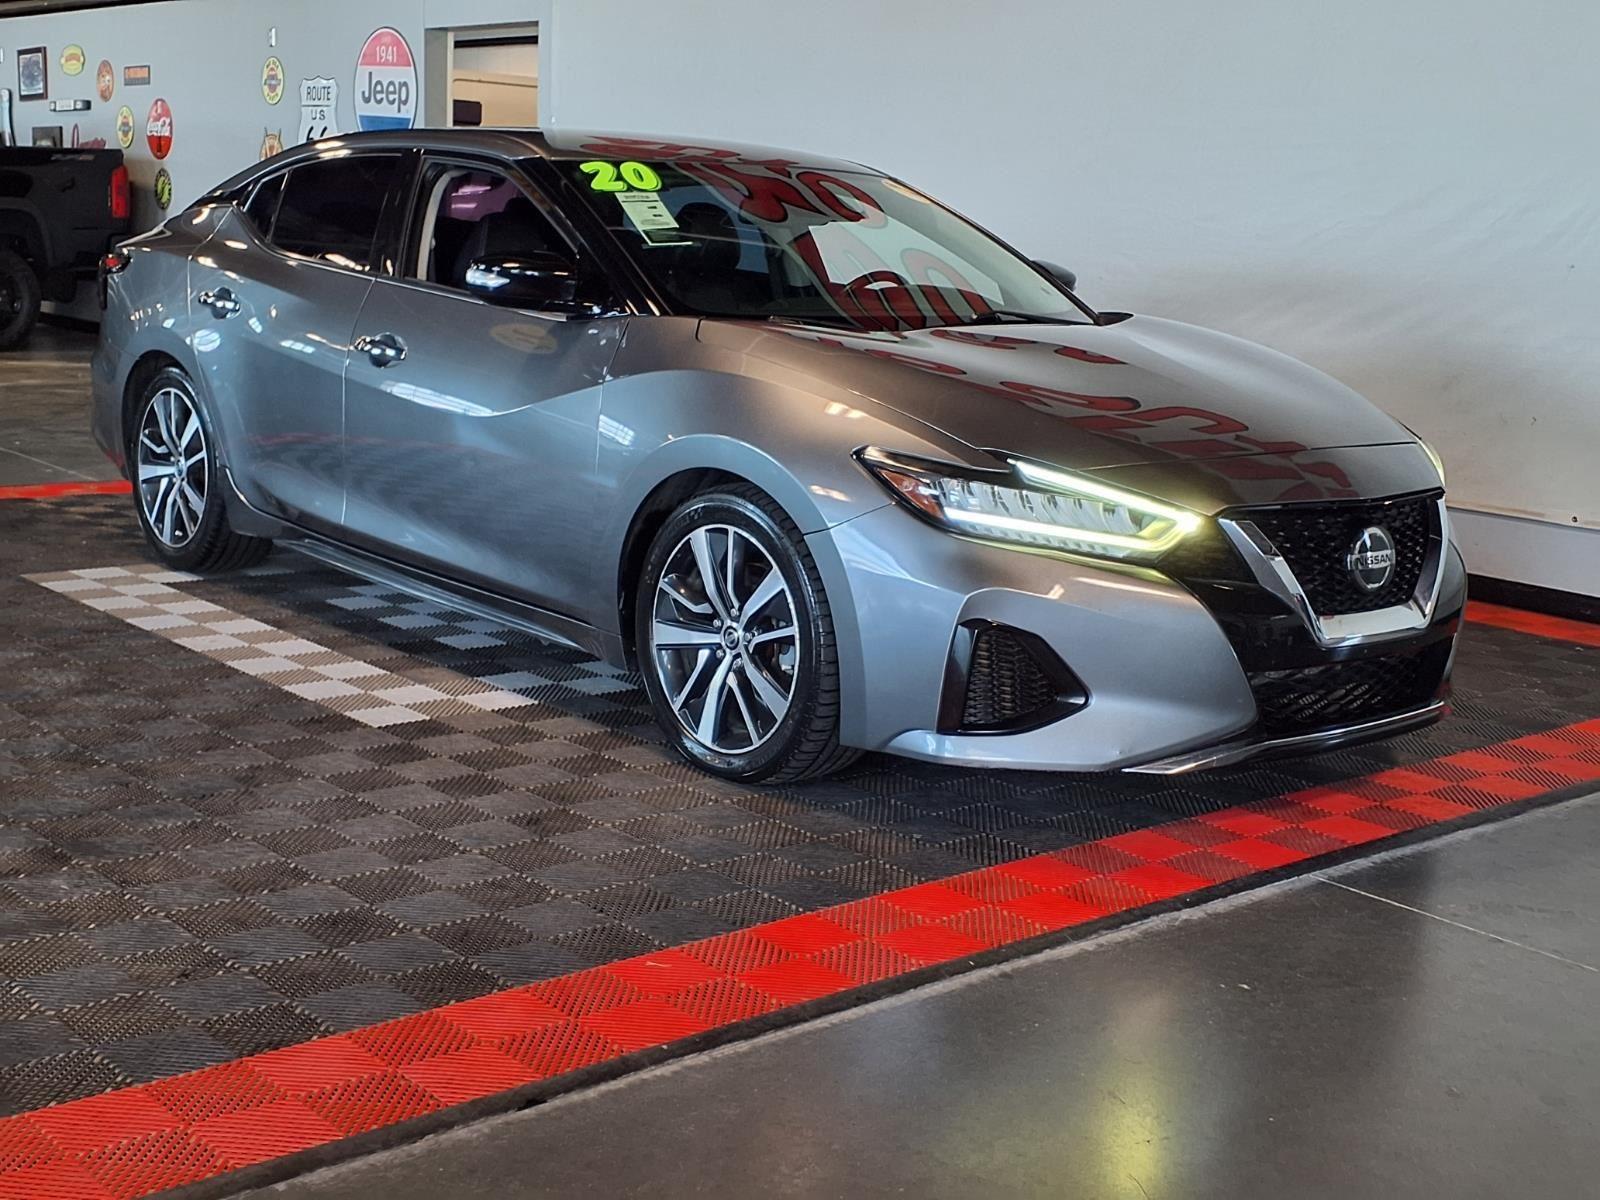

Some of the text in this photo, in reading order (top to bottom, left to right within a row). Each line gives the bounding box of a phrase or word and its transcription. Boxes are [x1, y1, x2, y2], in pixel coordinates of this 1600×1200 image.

[375, 46, 397, 63] 1941
[306, 86, 331, 101] ROUTE
[361, 71, 410, 113] Jeep
[579, 161, 662, 192] 20
[1356, 553, 1391, 567] NISSAN
